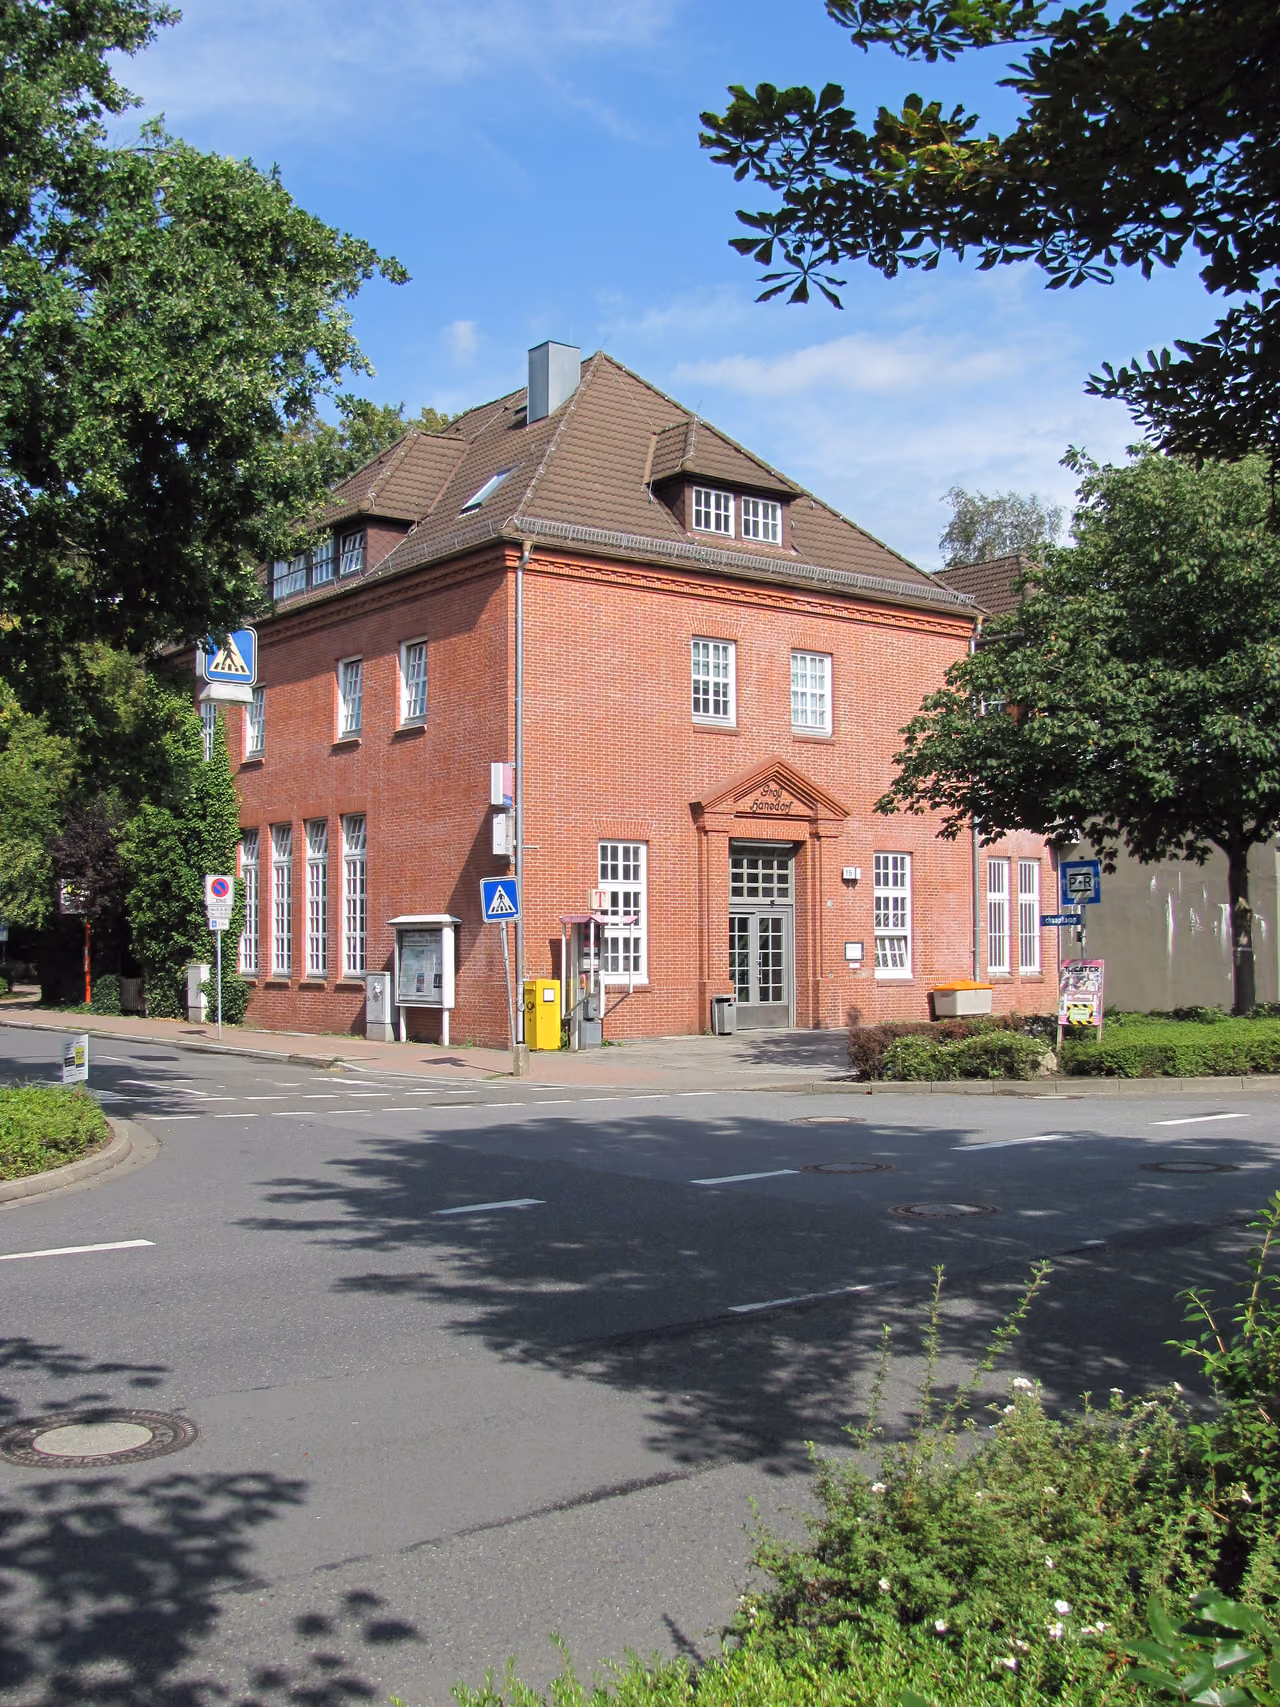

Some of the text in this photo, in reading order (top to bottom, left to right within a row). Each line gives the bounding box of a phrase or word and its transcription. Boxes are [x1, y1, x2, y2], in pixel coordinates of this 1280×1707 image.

[1069, 876, 1092, 889] P+R
[595, 891, 606, 908] T
[1064, 966, 1100, 974] THEATER
